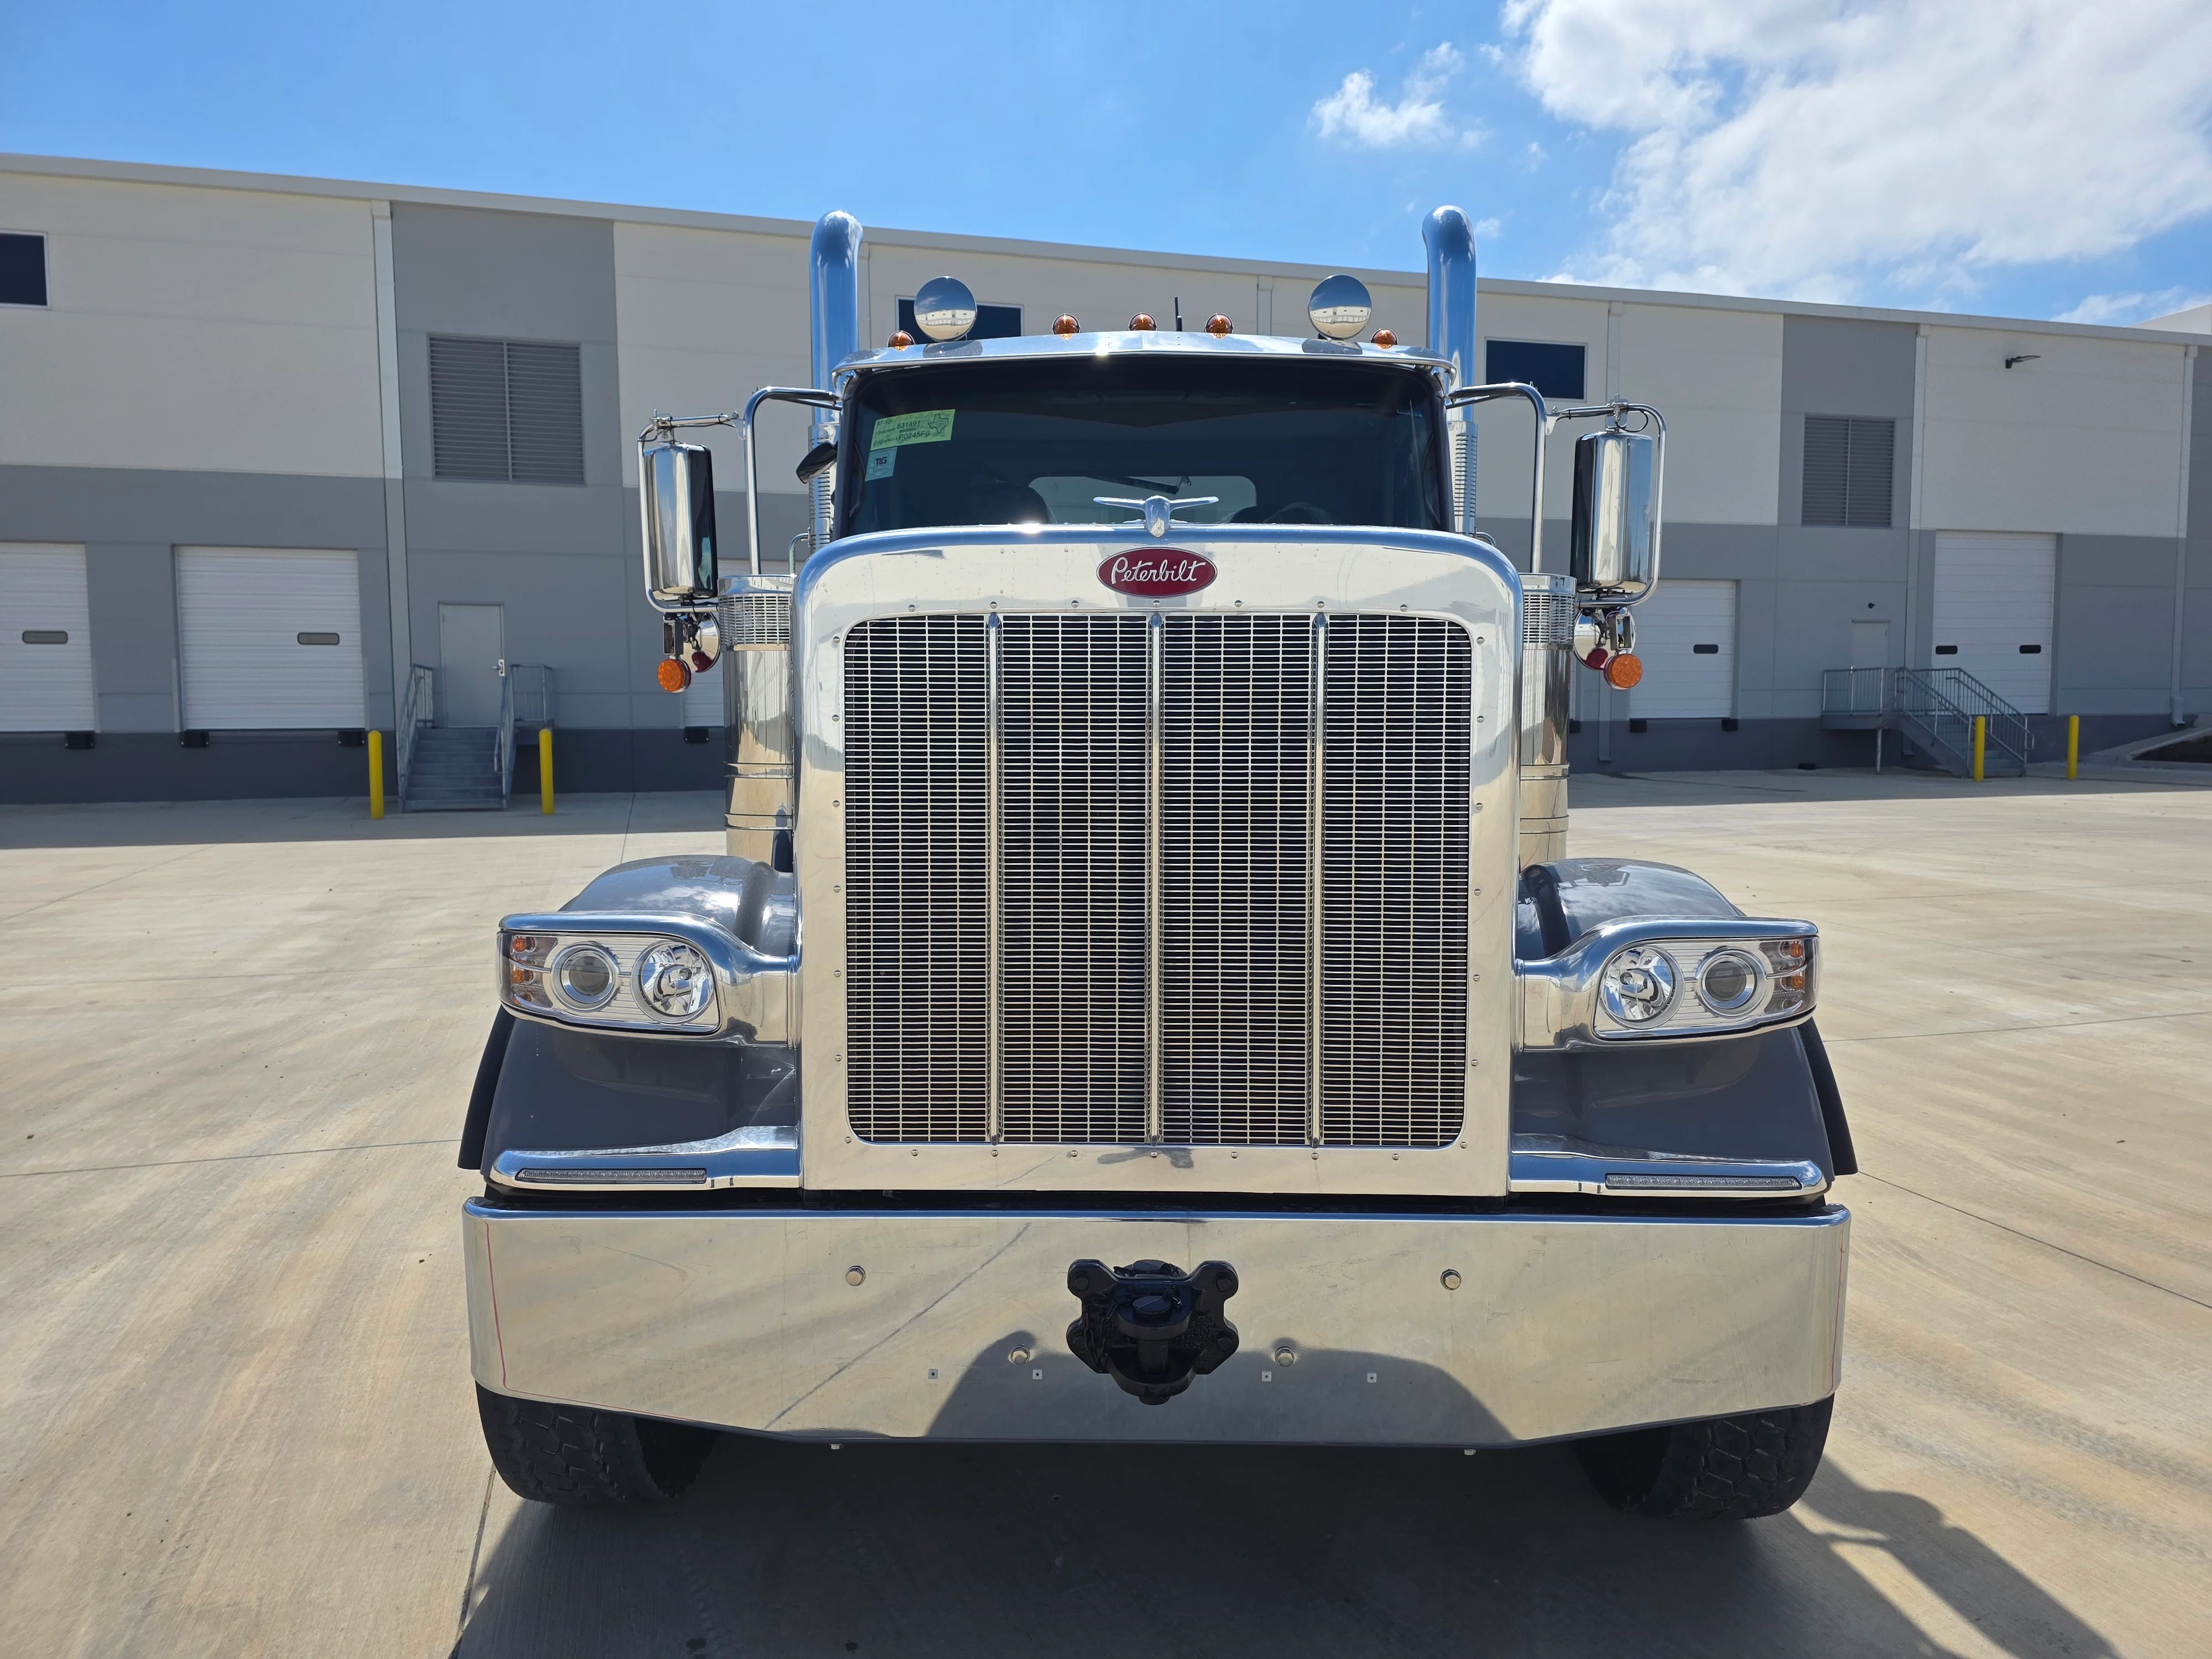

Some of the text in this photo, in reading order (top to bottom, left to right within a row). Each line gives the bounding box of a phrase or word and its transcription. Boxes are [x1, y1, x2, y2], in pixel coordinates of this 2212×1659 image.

[896, 420, 920, 429] 831491
[899, 430, 930, 440] P0245F0
[875, 456, 888, 466] TLG
[1111, 556, 1207, 585] Peterbilt
